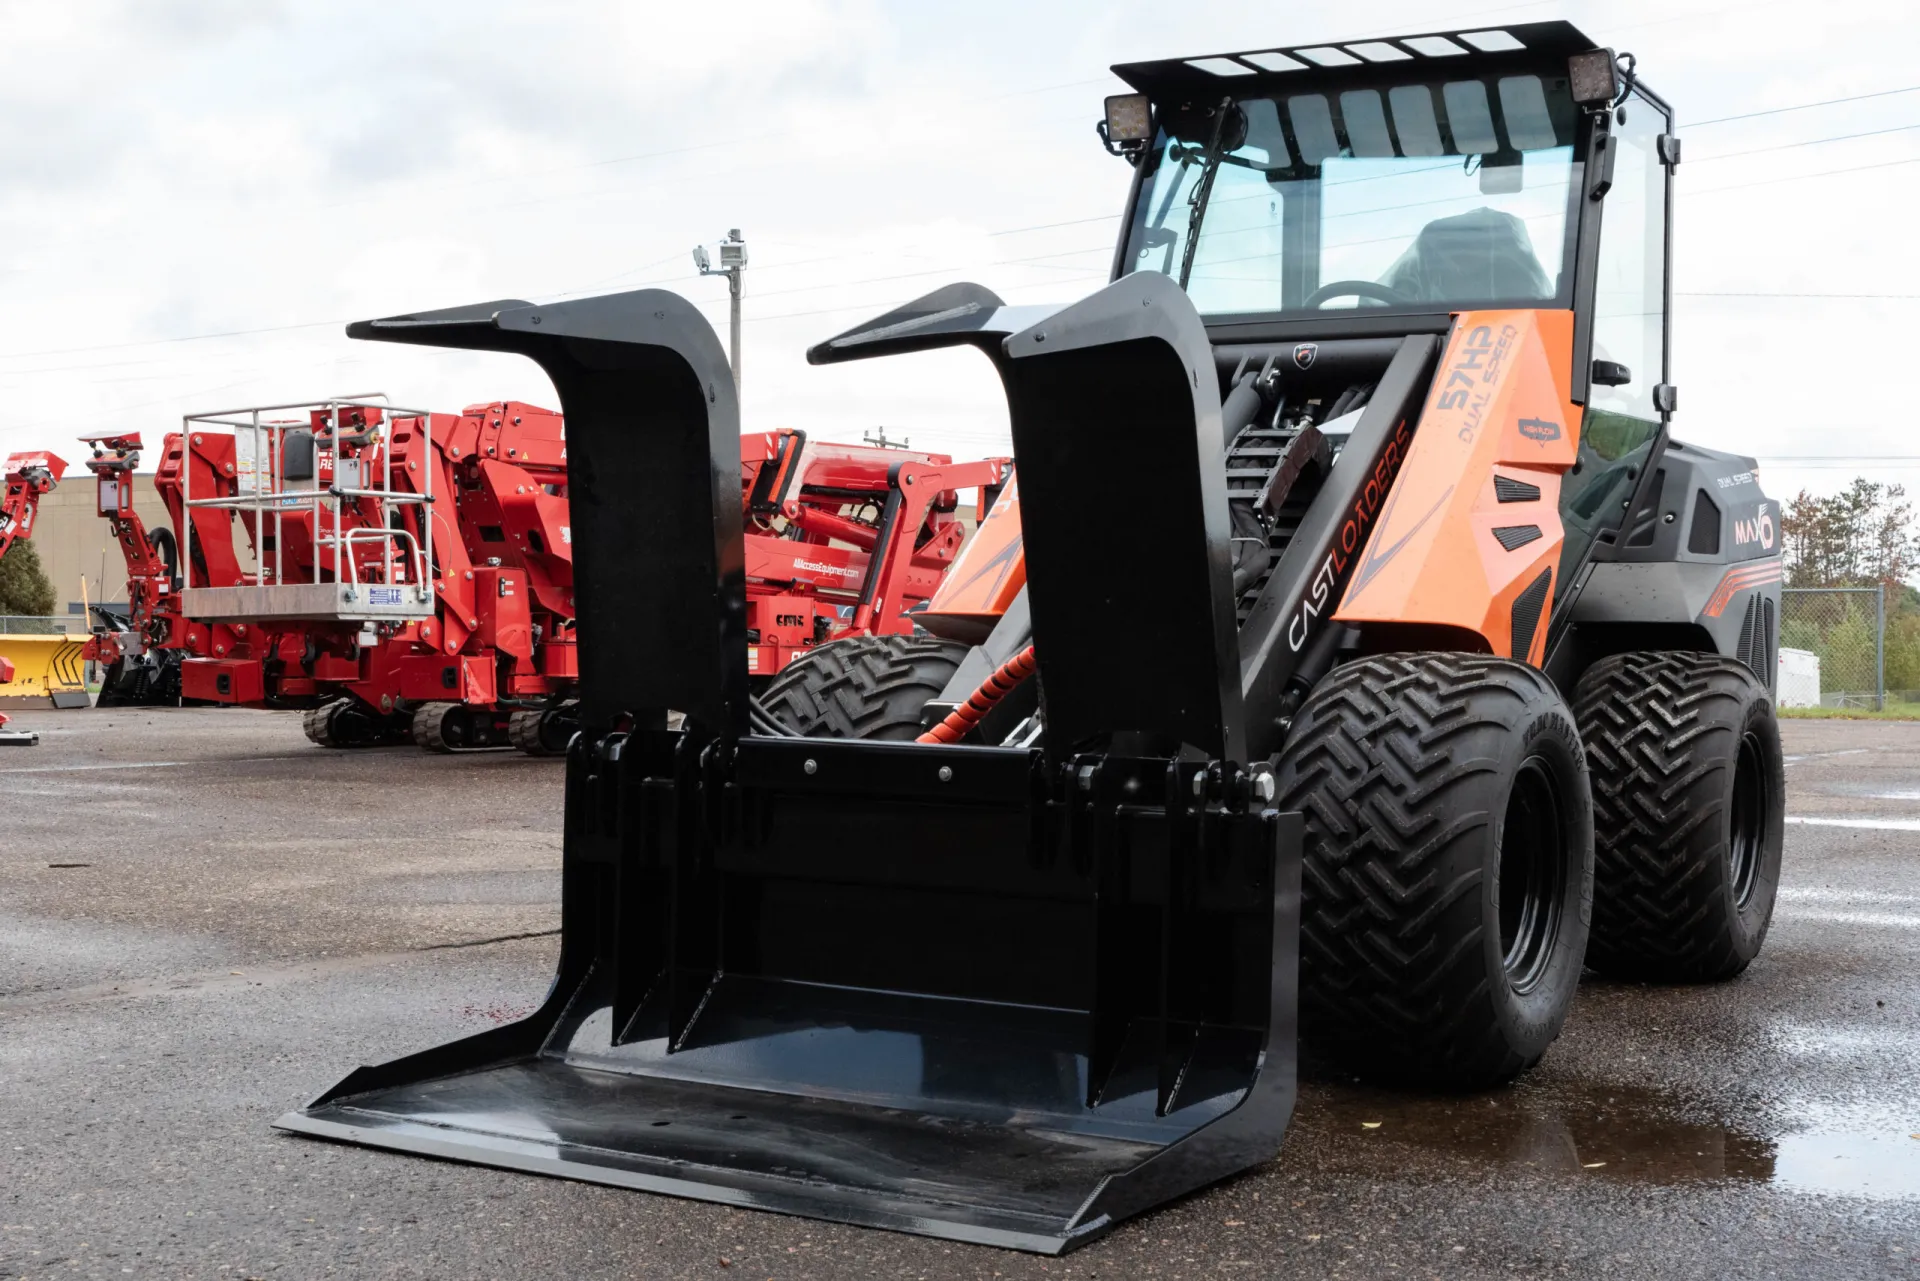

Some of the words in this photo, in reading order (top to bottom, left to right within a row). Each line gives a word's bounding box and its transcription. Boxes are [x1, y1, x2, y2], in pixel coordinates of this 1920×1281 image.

[1436, 325, 1494, 410] 57HP
[1457, 391, 1492, 445] DUAL
[1481, 324, 1518, 387] SPEED
